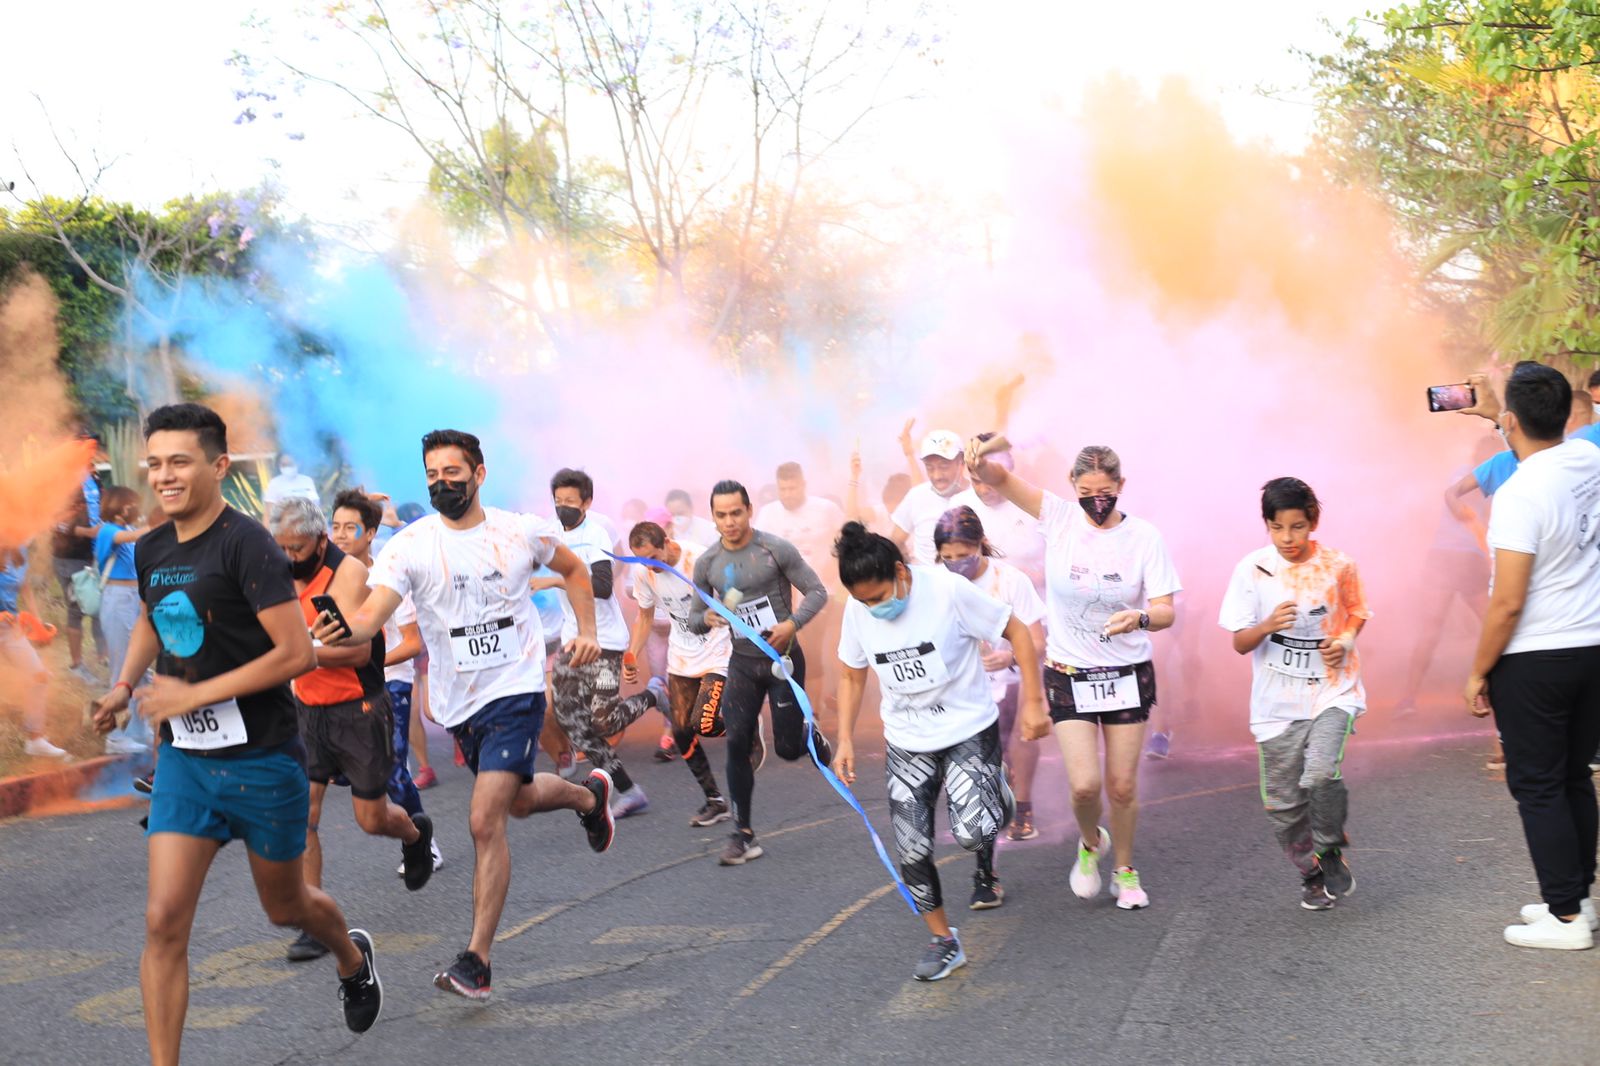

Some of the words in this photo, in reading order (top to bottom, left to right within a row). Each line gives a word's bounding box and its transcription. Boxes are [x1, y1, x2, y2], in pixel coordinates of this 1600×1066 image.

[464, 624, 485, 636] COLOR
[485, 621, 499, 633] RUN
[742, 614, 761, 628] 41
[468, 634, 501, 657] 052
[1283, 649, 1310, 669] 011
[893, 660, 926, 682] 058
[1087, 673, 1107, 681] COLOR
[1090, 682, 1116, 701] 114
[700, 681, 723, 733] Wilson
[181, 708, 219, 734] 056
